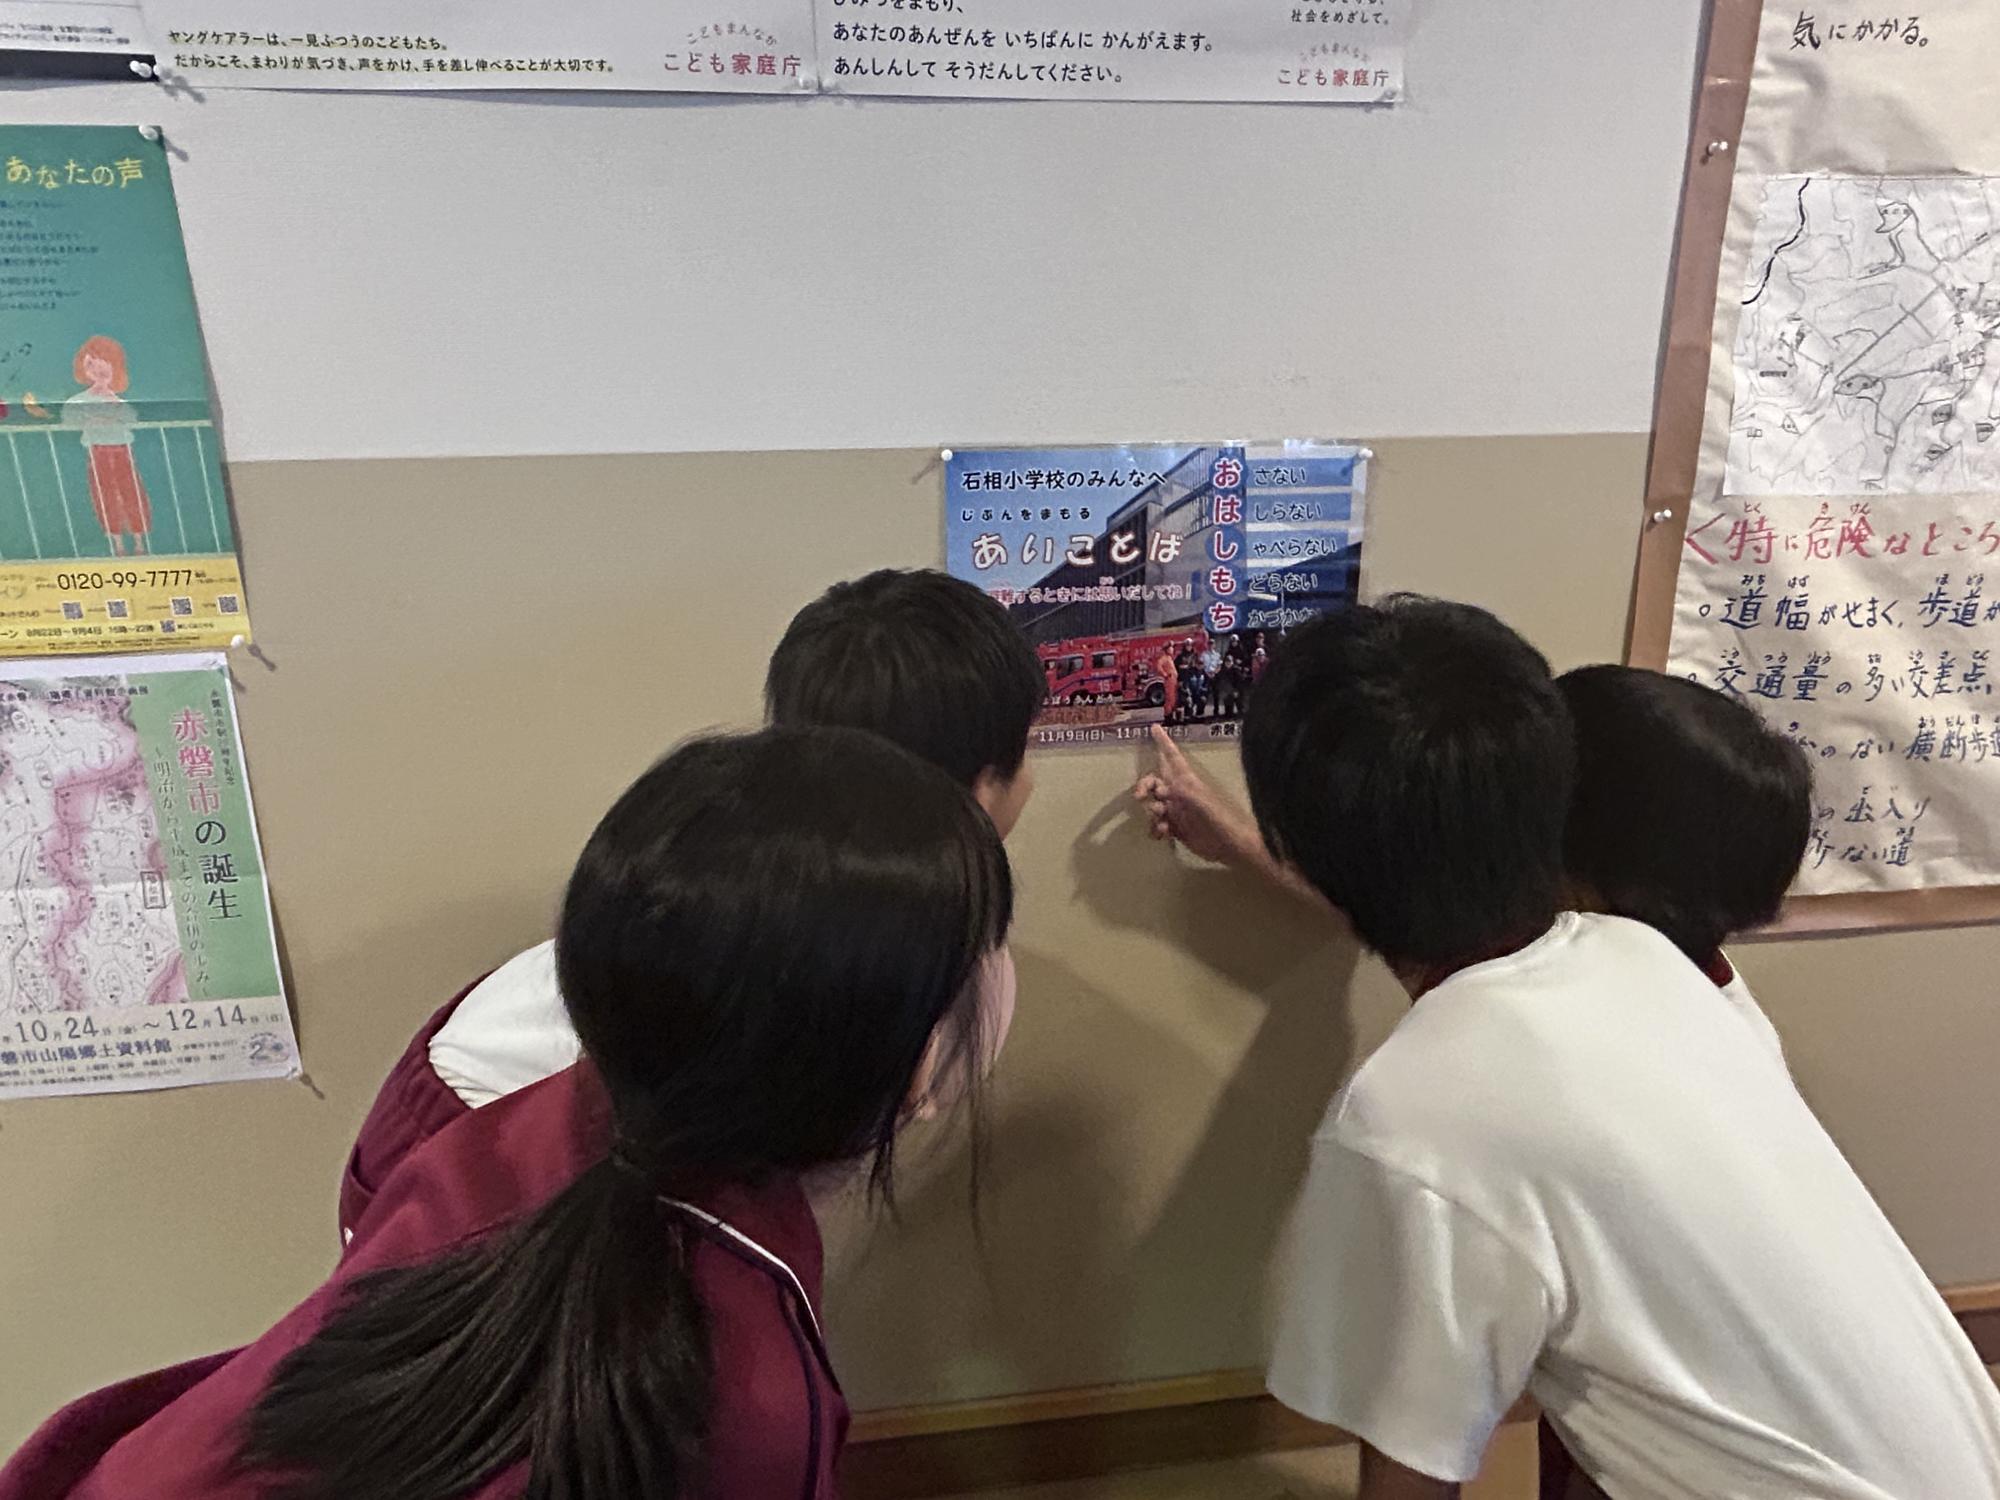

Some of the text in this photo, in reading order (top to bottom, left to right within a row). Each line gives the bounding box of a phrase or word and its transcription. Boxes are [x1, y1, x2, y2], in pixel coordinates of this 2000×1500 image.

[1291, 9, 1388, 25] 社会をめざして。
[169, 30, 447, 51] ヤングケアラーは、一見ふつうのこどもたち。
[833, 20, 1213, 53] あなたのあんぜんを いちばんに かんがえます。
[1790, 11, 1929, 50] 気にかかる。
[175, 54, 614, 74] だからこそ、まわりが気づき、声をかけ、手を差し伸べることが大切です。
[664, 51, 801, 77] こども家庭庁
[833, 57, 1123, 84] あんしんして そうだんしてください。
[1278, 67, 1390, 88] こども家庭庁
[6, 155, 144, 189] あなたの声
[961, 468, 1166, 492] 石相小学校のみんなへ
[1254, 467, 1307, 486] さない
[960, 506, 1092, 522] じぶんをまもる
[1254, 501, 1324, 522] しらない
[971, 529, 1185, 571] あいことば
[57, 569, 193, 591] 0120-99-7777
[1248, 573, 1319, 596] どらない
[170, 708, 243, 921] 赤磐市の誕生
